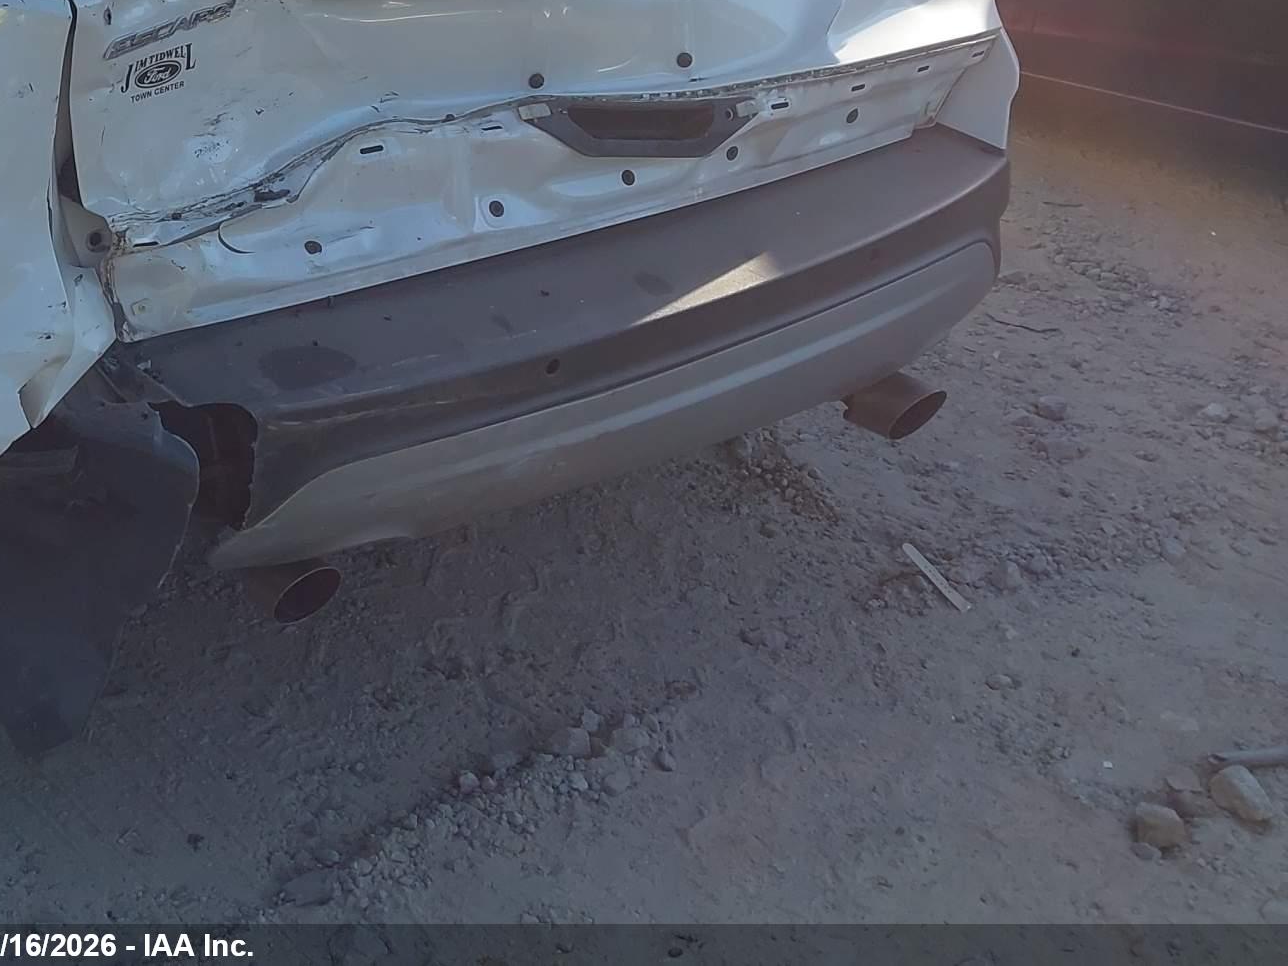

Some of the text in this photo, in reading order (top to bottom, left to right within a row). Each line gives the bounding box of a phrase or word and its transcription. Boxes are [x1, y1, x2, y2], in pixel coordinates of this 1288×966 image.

[120, 43, 197, 94] JIM TIDWELL
[143, 66, 173, 84] Ford
[130, 80, 185, 104] TOWN CENTER
